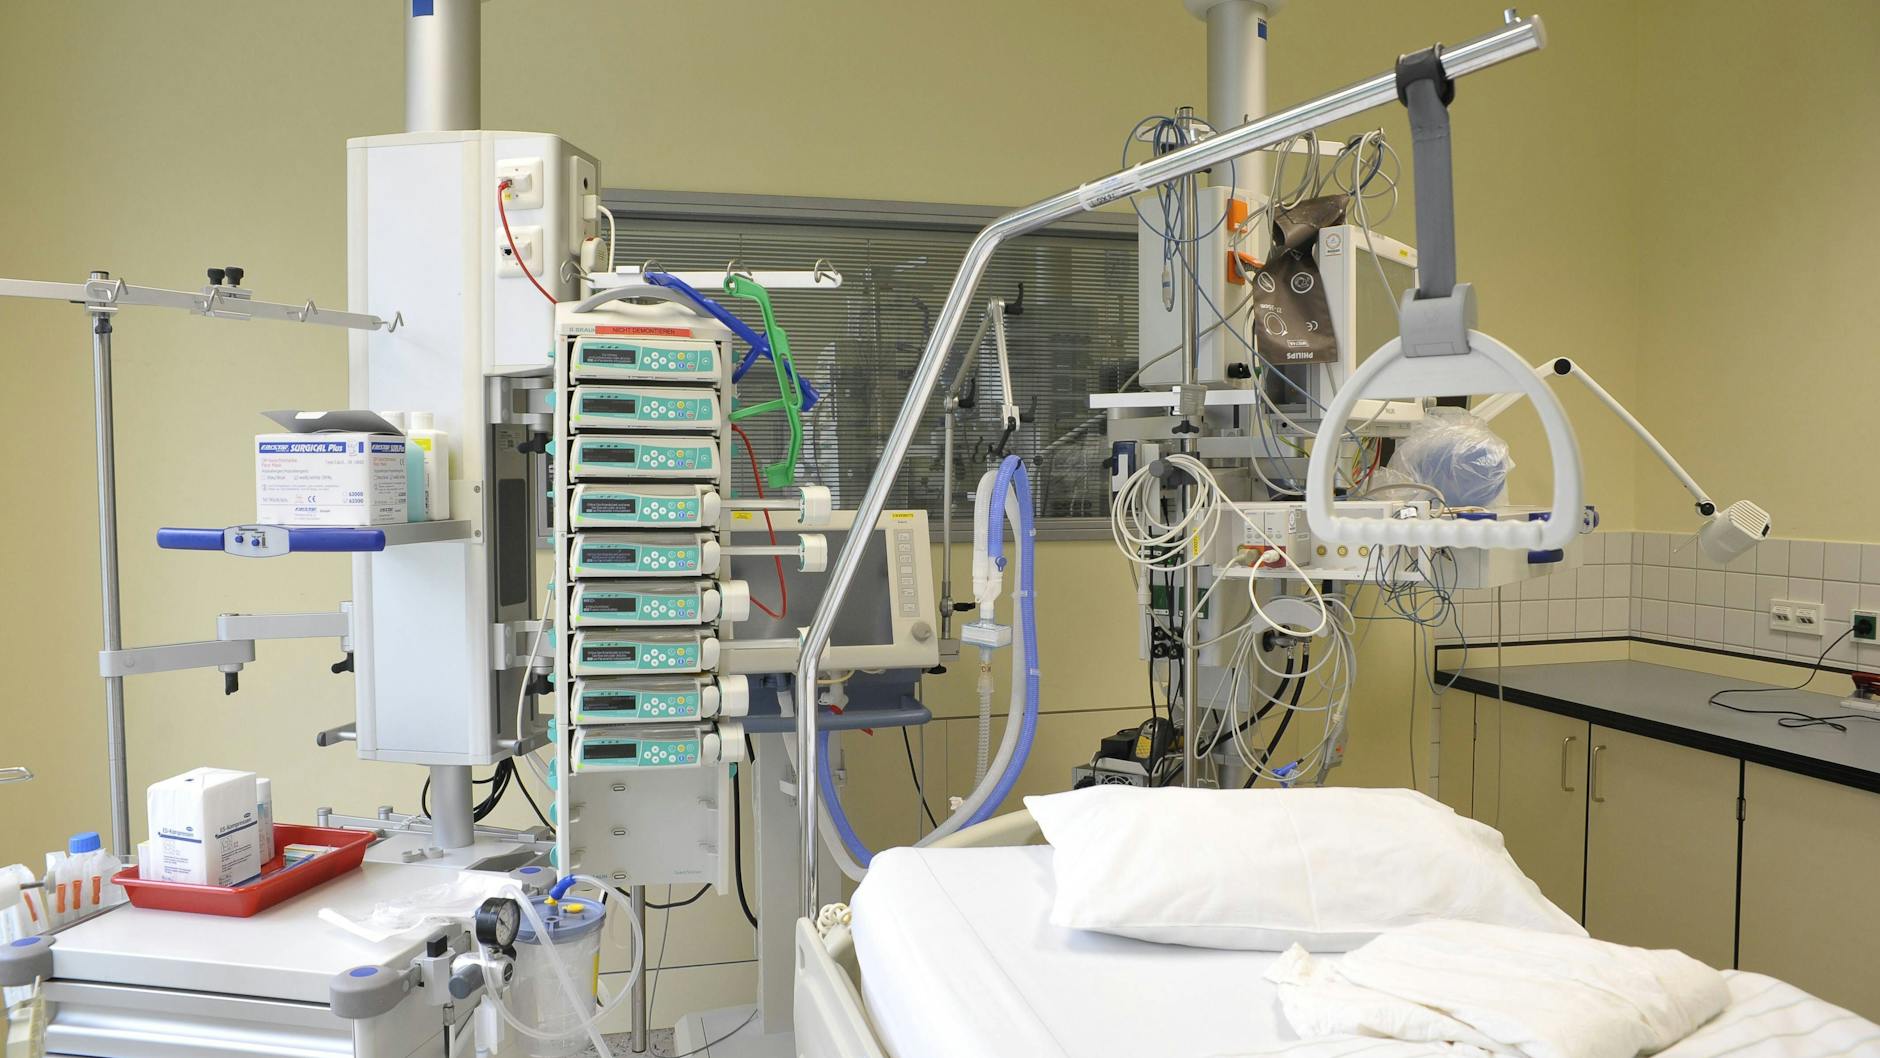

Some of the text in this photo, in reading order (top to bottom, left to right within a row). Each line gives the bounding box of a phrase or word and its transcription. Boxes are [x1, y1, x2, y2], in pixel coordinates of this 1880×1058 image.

[632, 327, 676, 335] DEMONTIEREN
[1286, 351, 1314, 360] PHILIPS
[290, 443, 326, 453] SURGICAL
[328, 443, 343, 453] Plus
